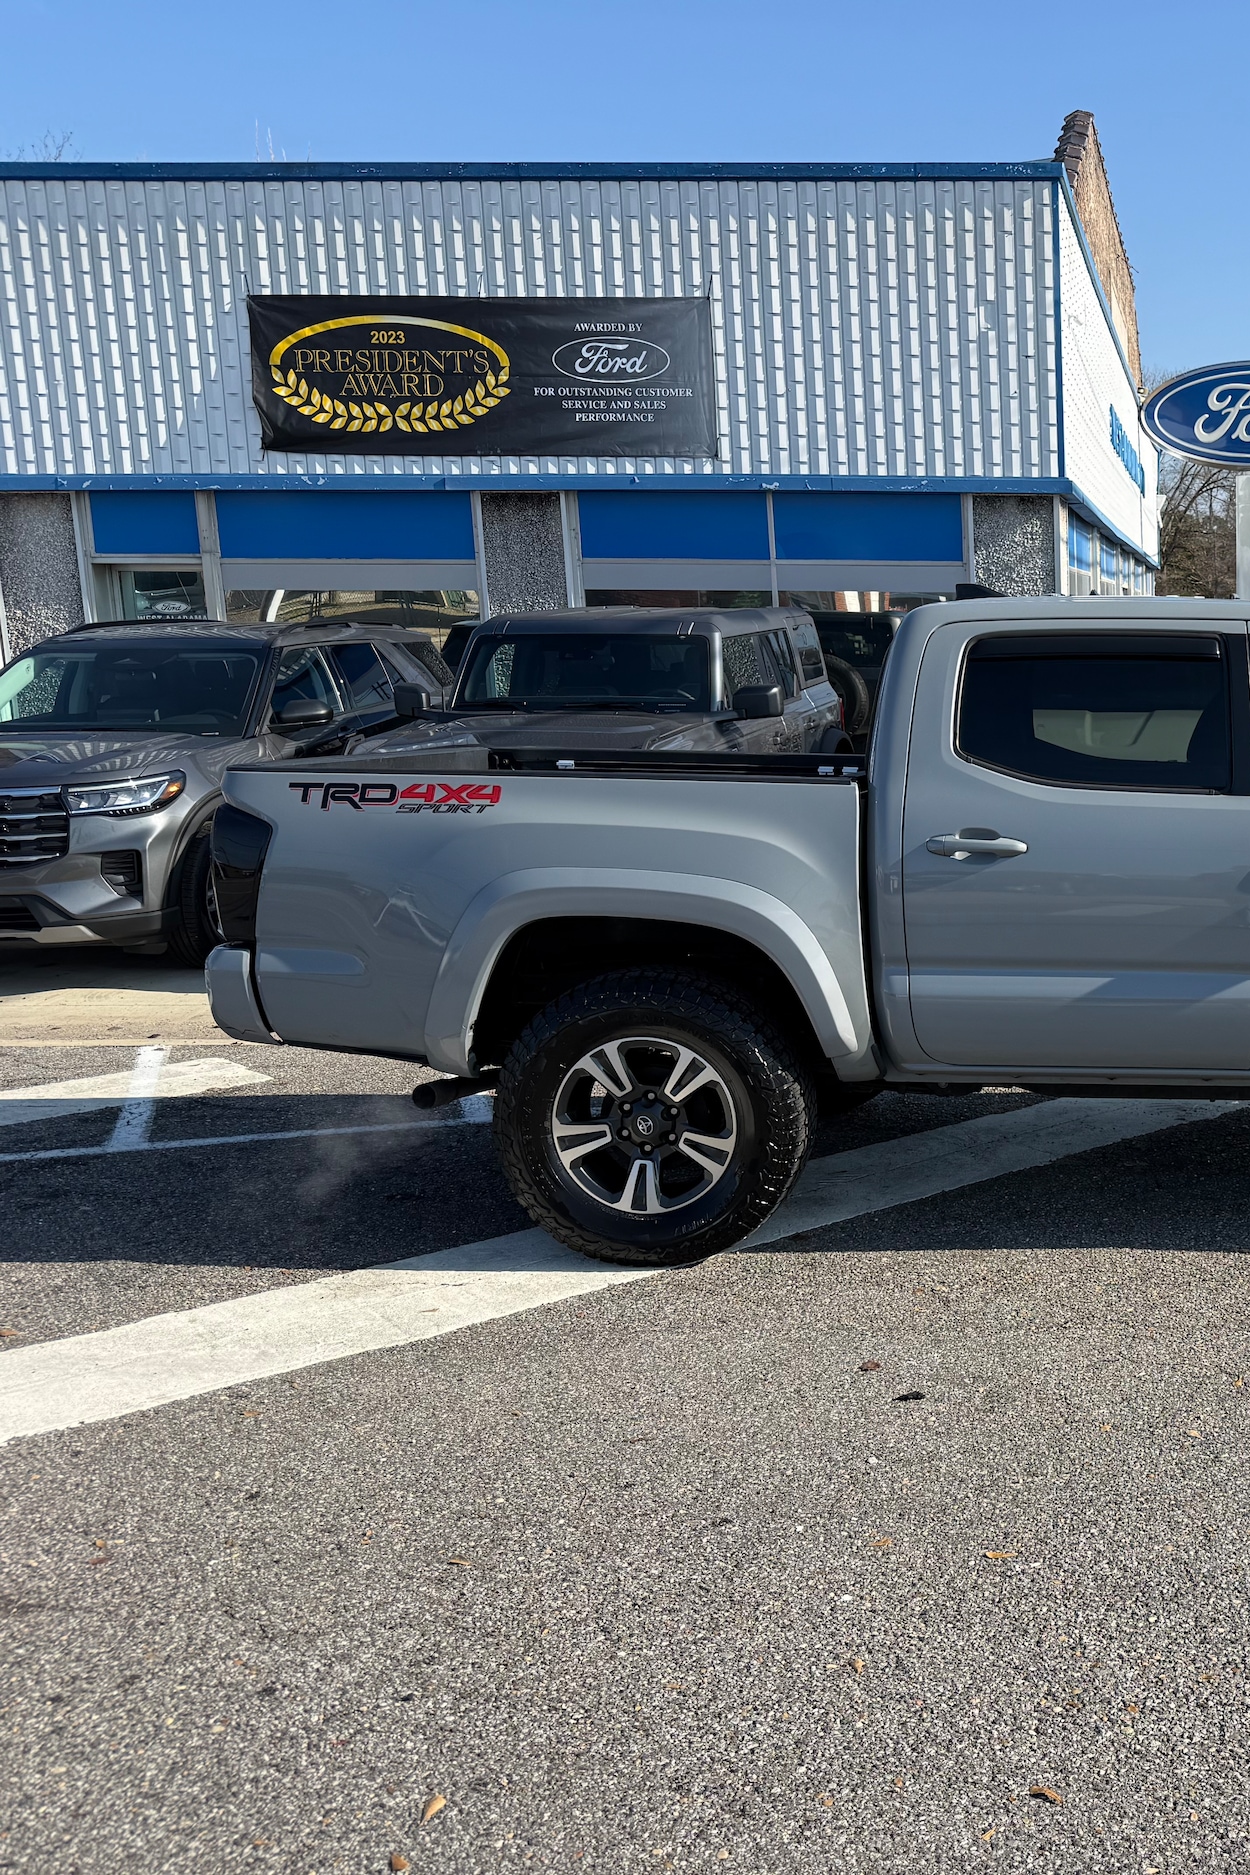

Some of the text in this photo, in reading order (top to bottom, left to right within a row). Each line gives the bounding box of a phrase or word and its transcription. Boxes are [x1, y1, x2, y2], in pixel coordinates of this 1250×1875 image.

[573, 322, 643, 333] AWARDED BY
[370, 330, 406, 345] 2023
[293, 348, 490, 374] PRESIDENT'S
[574, 342, 648, 374] Ford
[339, 373, 445, 397] AWARD
[533, 386, 693, 398] FOR OUTSTANDING CUSTOMER
[561, 400, 667, 410] SERVICE AND SALES
[575, 412, 655, 423] PERFORMANCE
[288, 782, 399, 812] TRD
[395, 803, 495, 814] SPORT
